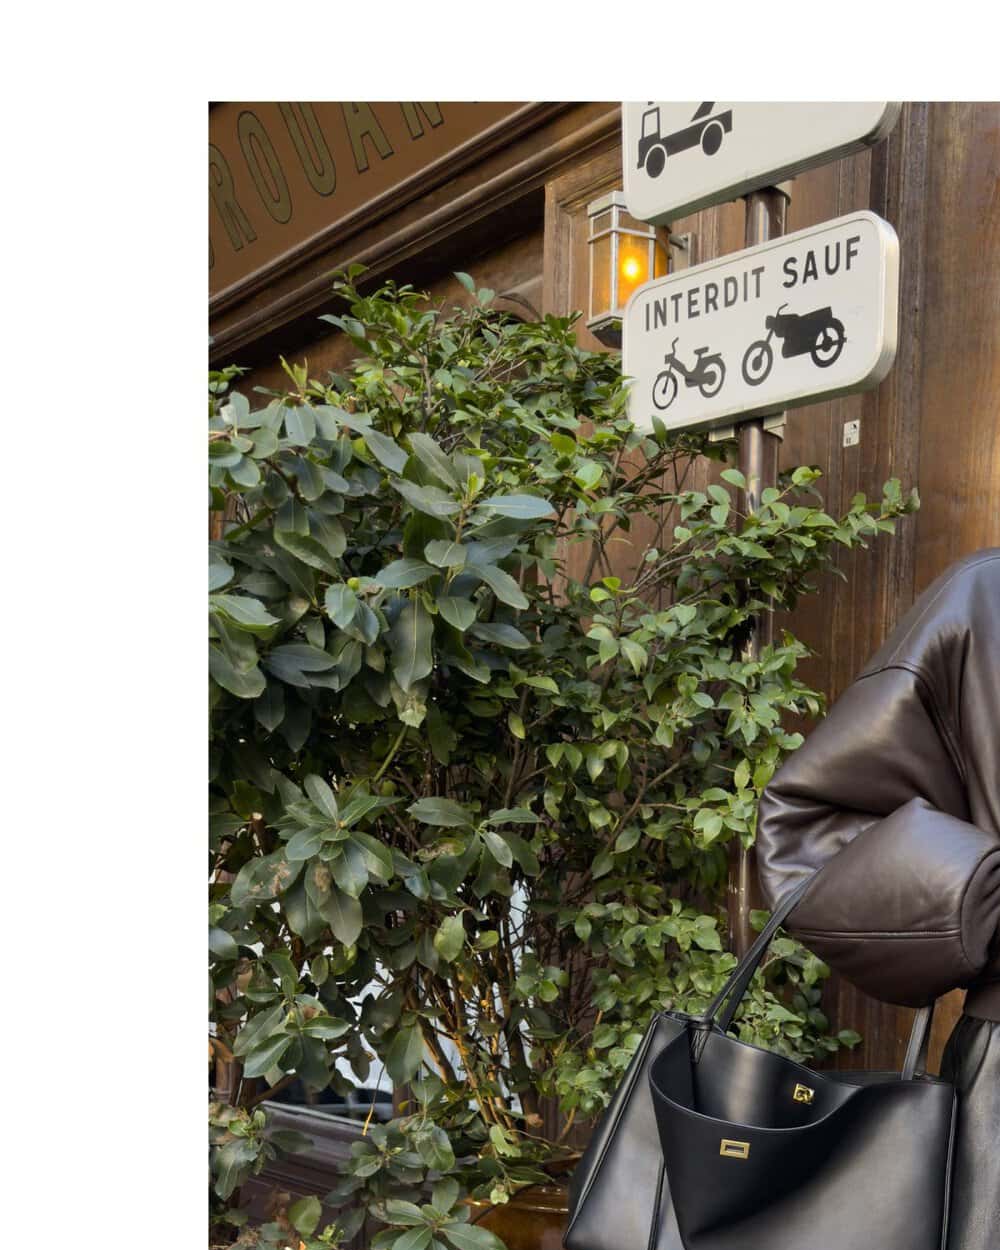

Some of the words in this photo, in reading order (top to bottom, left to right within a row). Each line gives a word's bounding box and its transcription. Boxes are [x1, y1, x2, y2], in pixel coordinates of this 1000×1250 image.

[209, 101, 444, 270] ROUA
[645, 266, 765, 332] INTERDIT
[783, 236, 861, 289] SAUF
